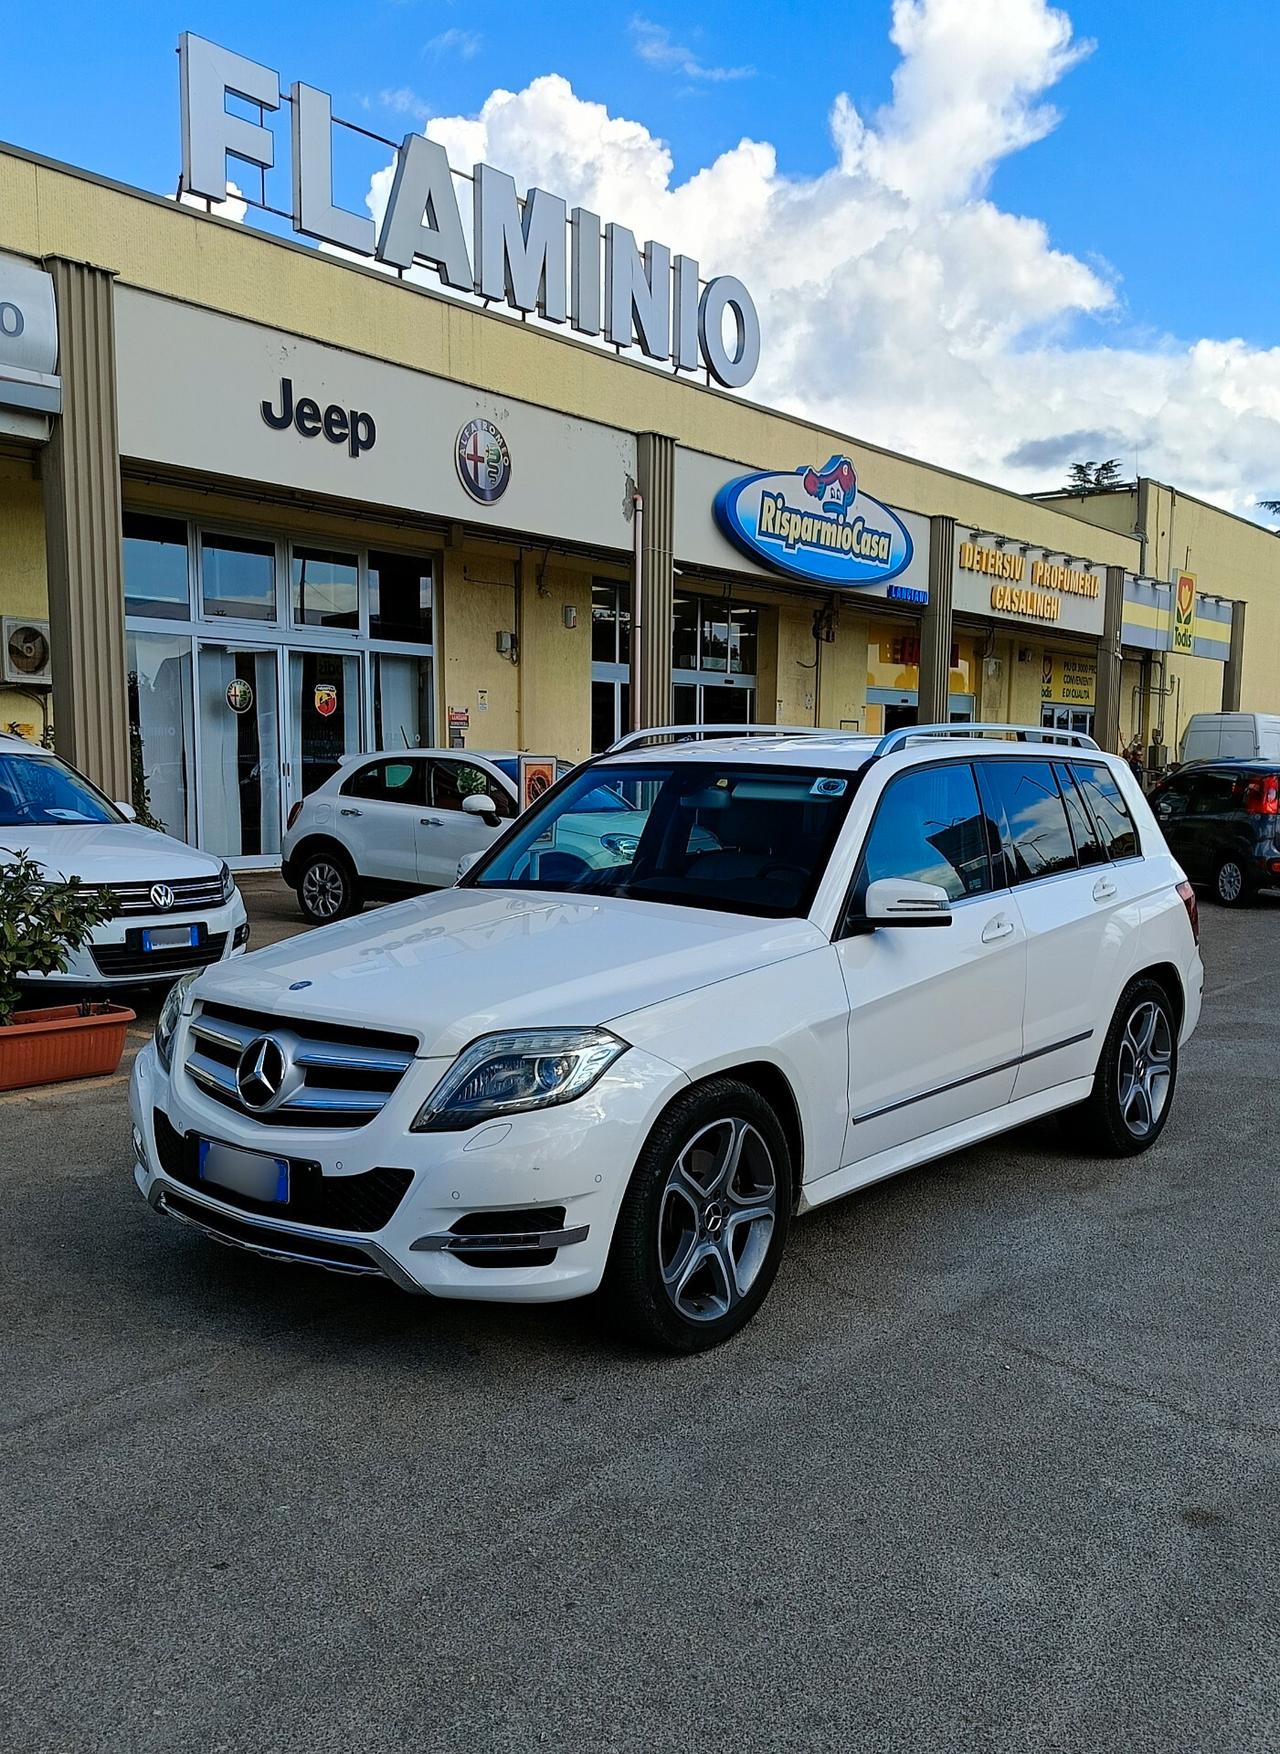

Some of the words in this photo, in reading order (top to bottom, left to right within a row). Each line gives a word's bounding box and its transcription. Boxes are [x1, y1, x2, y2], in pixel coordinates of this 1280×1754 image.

[178, 30, 761, 389] FLAMINIO
[260, 376, 376, 459] Jeep
[459, 422, 478, 458] ALFA
[482, 421, 510, 466] ROMEO
[760, 494, 890, 562] RisparmioCasa
[960, 542, 1025, 581] DETERSIVI
[1031, 560, 1100, 599] PROFUMERIA
[991, 584, 1062, 621] CASALINGHI
[1174, 626, 1192, 648] Todis
